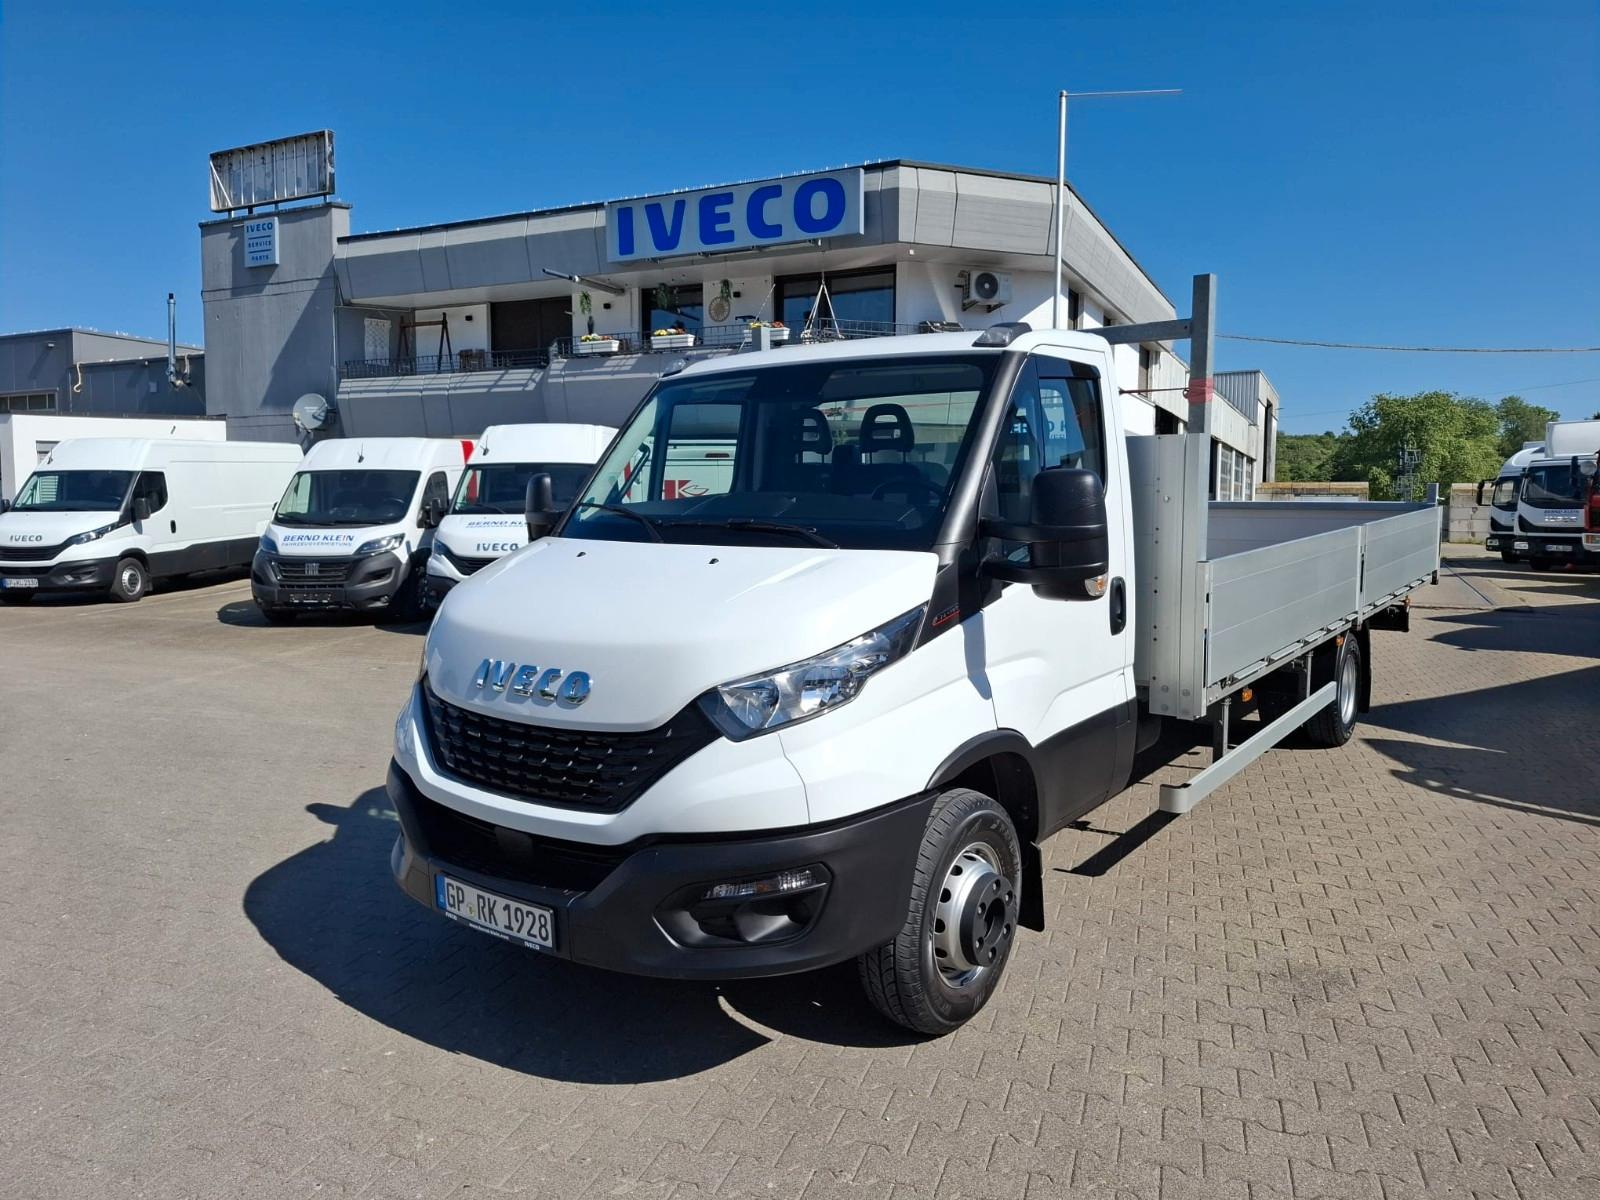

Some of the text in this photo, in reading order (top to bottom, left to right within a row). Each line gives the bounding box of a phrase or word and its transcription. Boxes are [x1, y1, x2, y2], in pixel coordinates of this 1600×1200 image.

[617, 177, 846, 256] IVECO
[246, 222, 273, 233] IVECO
[248, 240, 272, 248] SERVICE
[283, 534, 355, 542] BERND KLEIN
[476, 543, 519, 552] IVECO
[475, 657, 592, 705] IVECO
[446, 882, 465, 911] GP
[476, 893, 498, 927] RK
[502, 903, 550, 942] 1928
